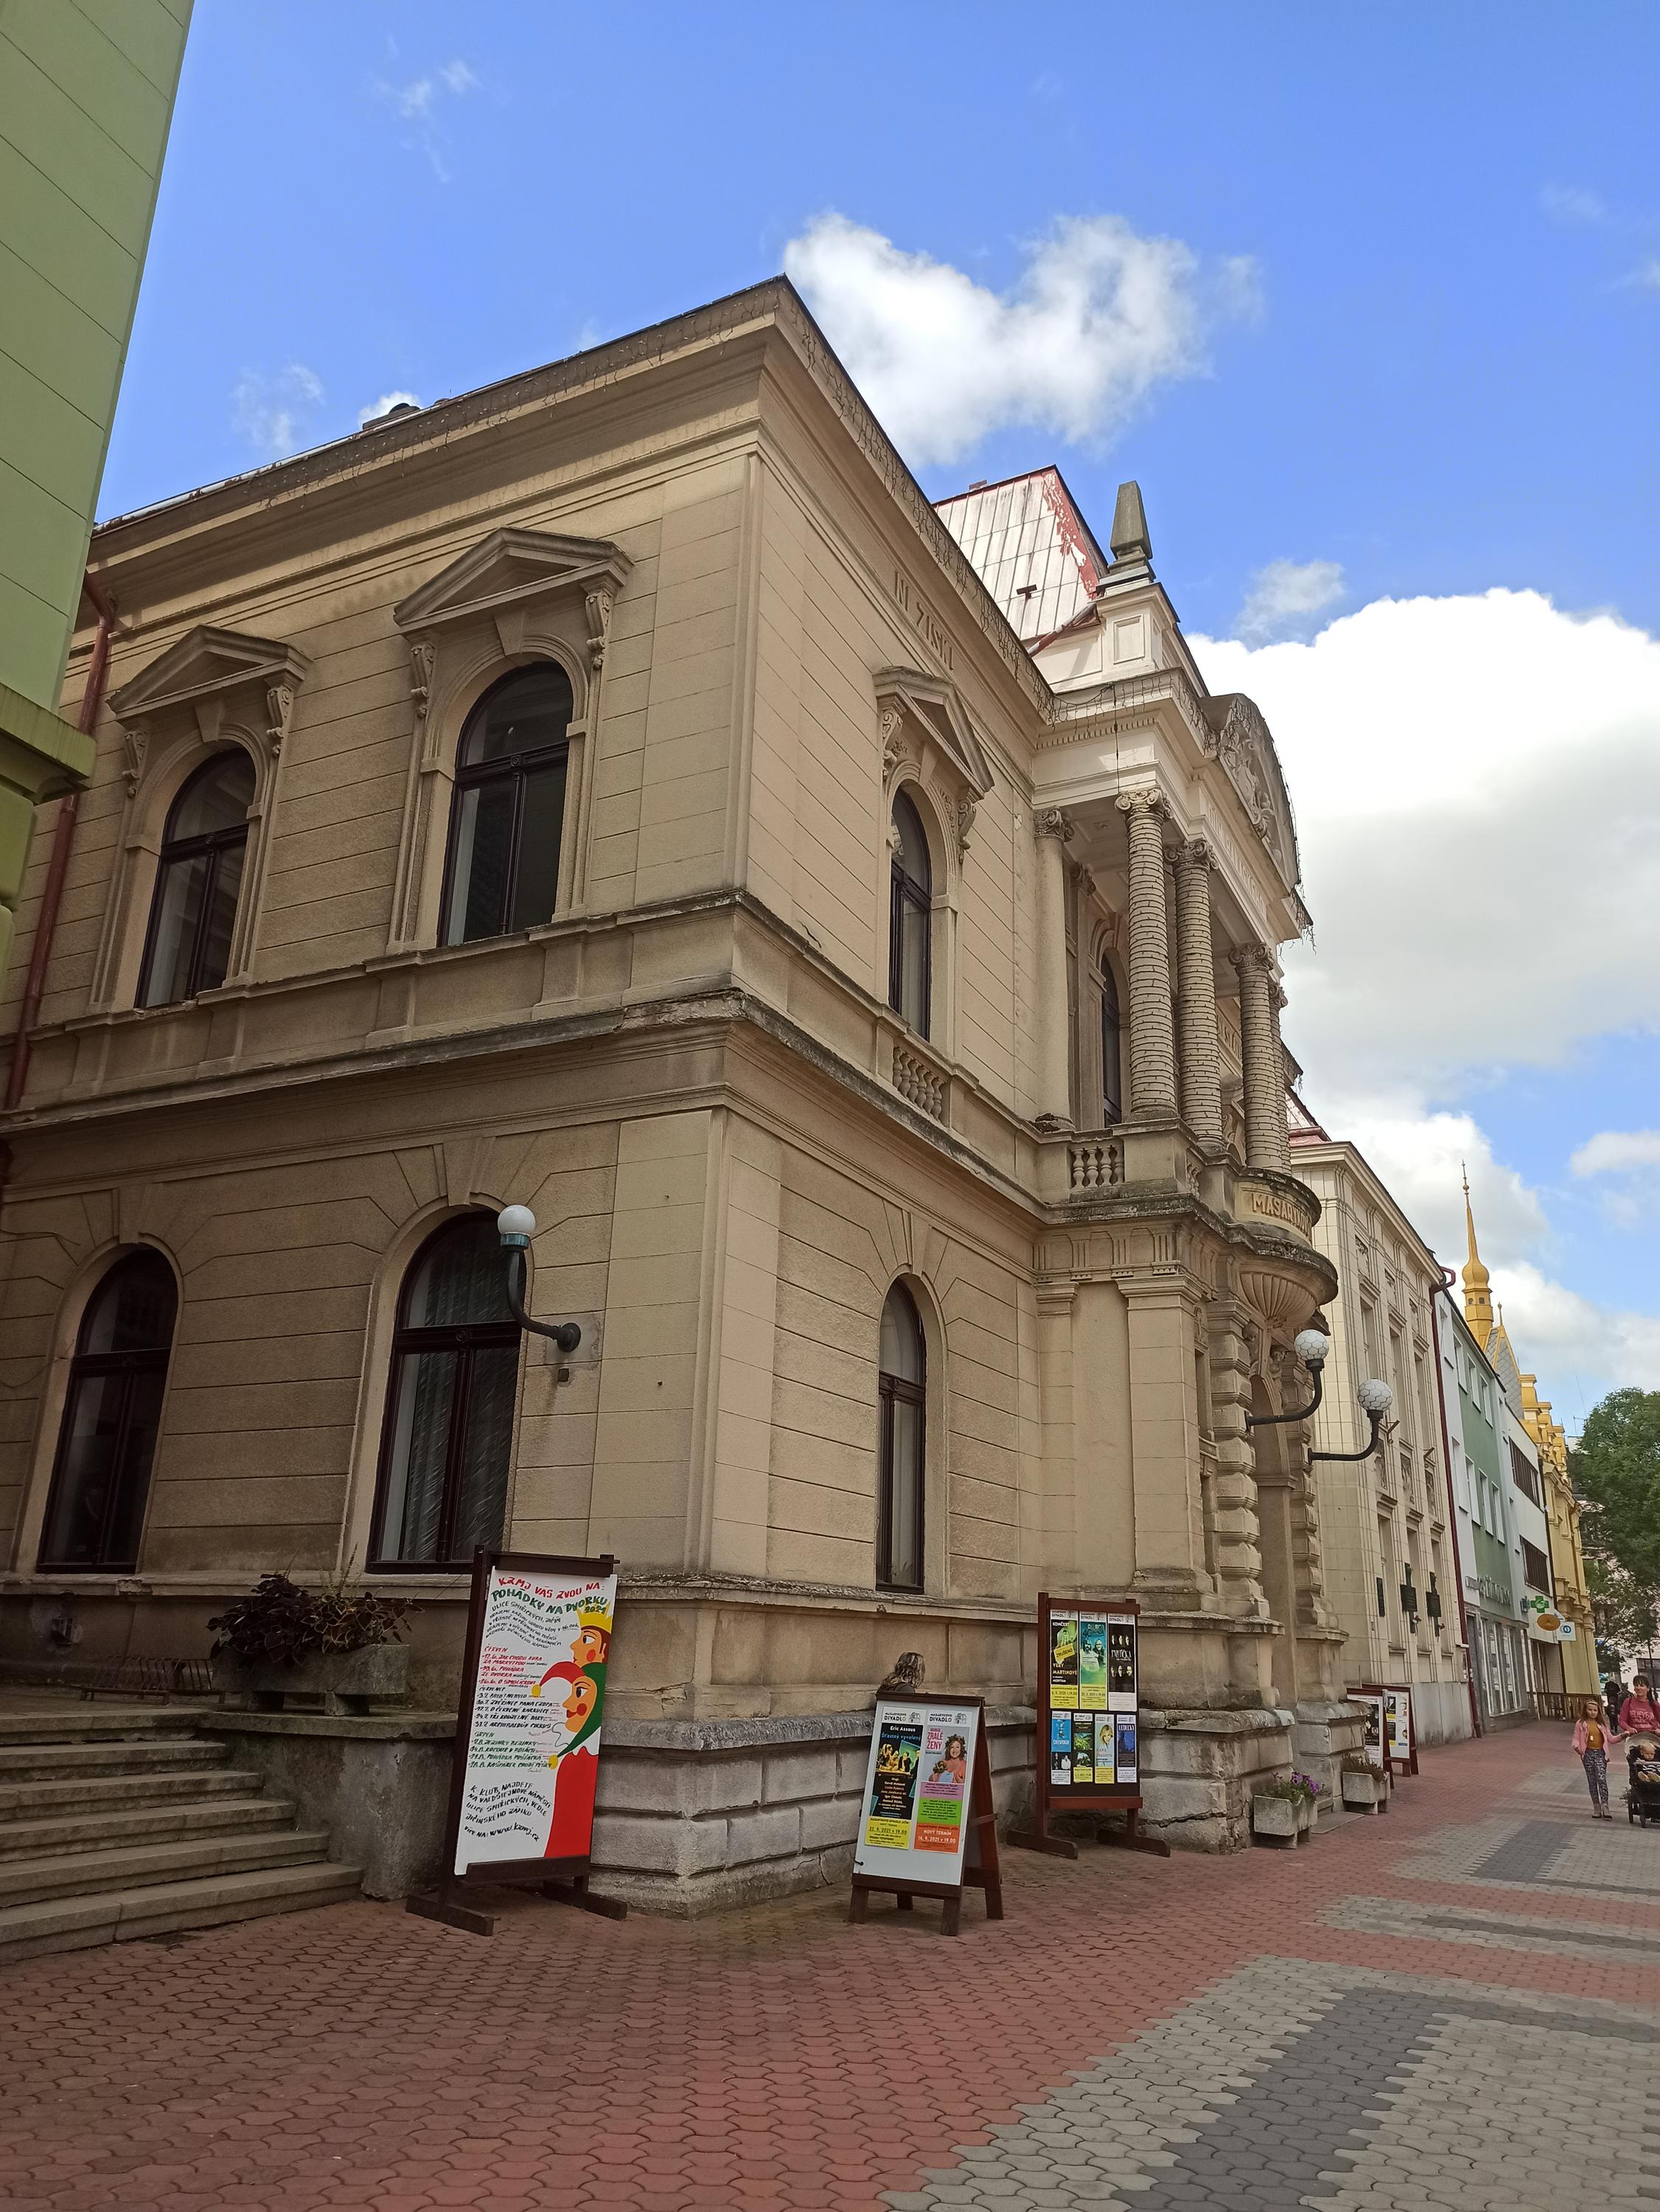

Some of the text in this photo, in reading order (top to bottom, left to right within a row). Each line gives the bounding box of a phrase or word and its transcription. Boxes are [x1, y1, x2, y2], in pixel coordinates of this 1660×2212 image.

[534, 1586, 553, 1598] VÁS
[556, 1587, 582, 1599] ZVOU
[491, 1588, 607, 1614] POHÁDKY NA DVORKU
[492, 1601, 509, 1611] ULICE
[585, 1606, 606, 1615] 2021
[484, 1644, 508, 1652] ČERVEN
[927, 1732, 944, 1741] ZRALÉ
[927, 1741, 942, 1750] ŽENY
[501, 1781, 532, 1791] NAJDETE
[467, 1793, 478, 1801] NA
[466, 1802, 484, 1813] ULICE
